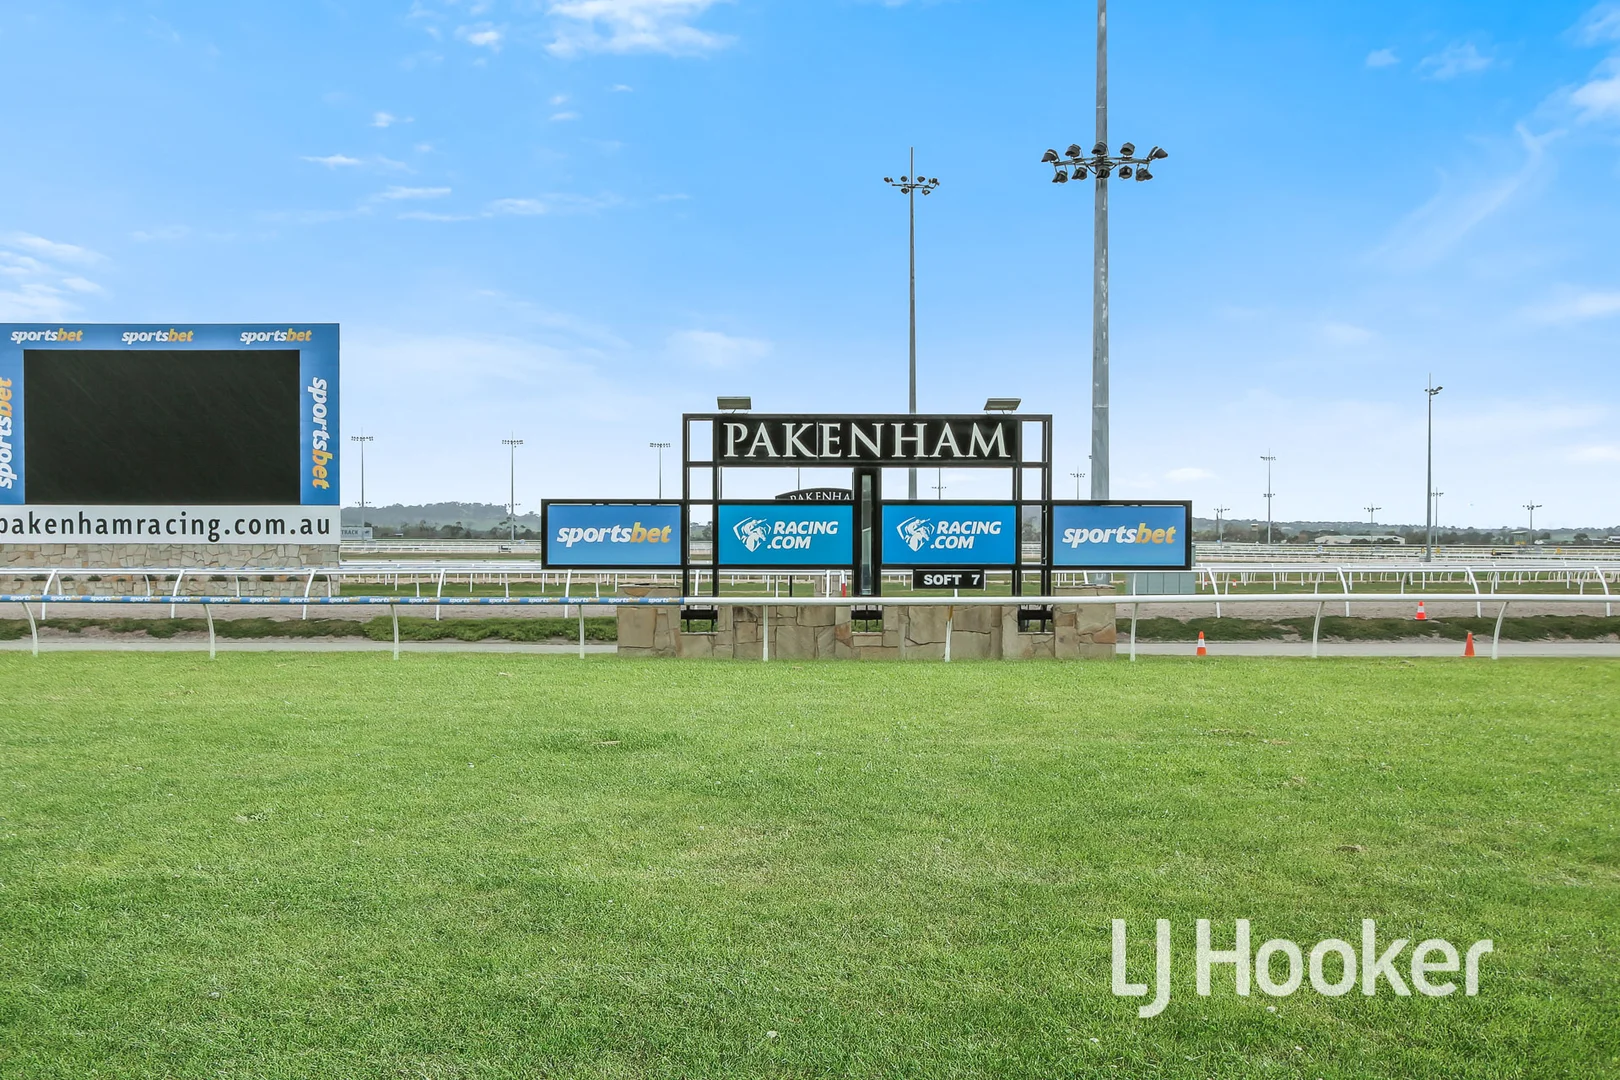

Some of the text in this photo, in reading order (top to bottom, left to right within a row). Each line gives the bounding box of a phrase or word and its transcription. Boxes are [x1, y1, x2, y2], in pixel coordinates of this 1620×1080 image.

[10, 328, 83, 344] sportsbet
[121, 329, 194, 345] sportsbet
[240, 328, 312, 345] sportsbet
[307, 376, 333, 490] sportsbet
[723, 421, 1011, 460] PAKENHAM
[789, 490, 852, 501] PAKENHA
[556, 521, 672, 548] sportsbet
[773, 520, 839, 535] RACING
[936, 520, 1002, 535] RACING
[1061, 522, 1177, 548] sportsbet
[923, 574, 981, 586] SOFT 7
